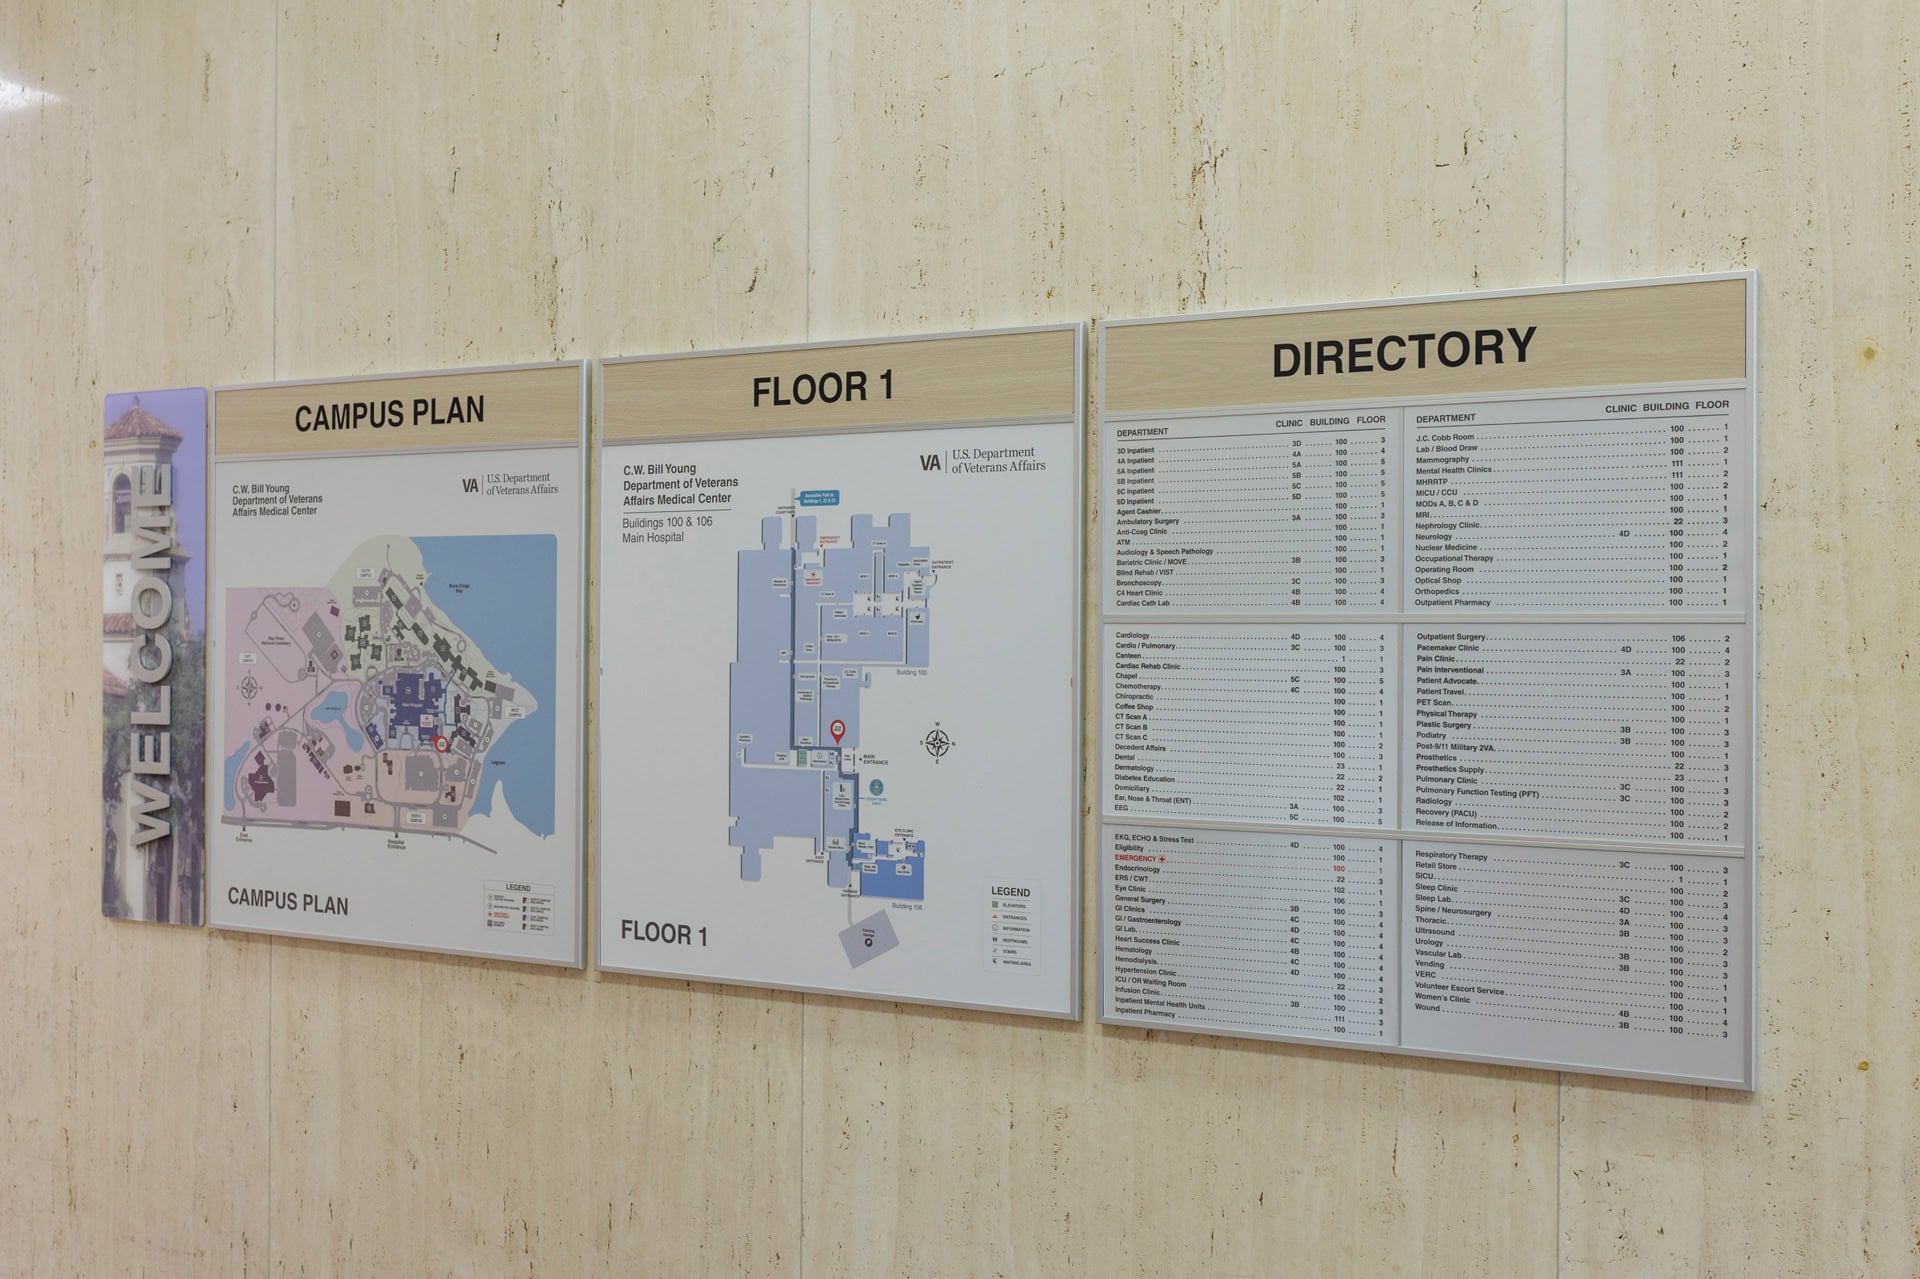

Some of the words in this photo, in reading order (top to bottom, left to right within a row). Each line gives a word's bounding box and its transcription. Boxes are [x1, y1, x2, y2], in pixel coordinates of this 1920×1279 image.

[1274, 326, 1537, 377] DIRECTORY
[754, 371, 866, 407] FLOOR
[880, 369, 891, 399] 1
[296, 400, 403, 432] CAMPUS
[414, 395, 484, 425] PLAN
[1417, 414, 1476, 423] DEPARTMENT
[1606, 404, 1636, 413] CLINIC
[1643, 402, 1689, 411] BUILDING
[1696, 400, 1729, 409] FLOOR
[1117, 428, 1168, 437] DEPARTMENT
[1310, 417, 1349, 426] BUILDING
[952, 449, 970, 460] U.S.
[974, 448, 1034, 461] Department
[1416, 456, 1469, 464] Mammography
[920, 455, 941, 470] VA
[952, 462, 963, 473] of
[964, 463, 1007, 473] Veterans
[1010, 460, 1046, 471] Affairs
[624, 465, 645, 476] C.W.
[648, 464, 663, 474] Bill
[665, 464, 696, 475] Young
[462, 478, 478, 492] VA
[488, 474, 501, 483] U.S.
[503, 473, 550, 485] Department
[624, 480, 680, 492] Department
[683, 478, 693, 488] of
[695, 478, 738, 488] Veterans
[233, 485, 249, 494] C.W.
[252, 484, 264, 493] Bill
[266, 484, 289, 496] Young
[487, 486, 496, 495] of
[494, 486, 529, 495] Veterans
[530, 484, 558, 494] Affairs
[233, 496, 277, 507] Department
[279, 494, 288, 504] of
[289, 495, 322, 504] Veterans
[624, 496, 654, 506] Affairs
[658, 494, 695, 504] Medical
[698, 493, 732, 503] Center
[232, 508, 257, 516] Affairs
[260, 506, 289, 516] Medical
[291, 506, 317, 515] Center
[623, 518, 663, 530] Buildings
[667, 517, 683, 527] 100
[686, 516, 692, 526] &
[697, 516, 712, 526] 106
[623, 533, 644, 543] Main
[647, 532, 684, 544] Hospital
[1417, 633, 1454, 641] Outpatient
[1457, 633, 1485, 642] Surgery
[130, 462, 172, 848] WELCOME
[1115, 764, 1154, 772] Dermatology
[1416, 797, 1452, 806] Radiology
[1416, 850, 1457, 860] Respiratory
[1458, 853, 1488, 862] Therapy
[1115, 864, 1160, 874] Endocrinology
[992, 886, 1030, 897] LEGEND
[228, 887, 297, 910] CAMPUS
[304, 894, 348, 915] PLAN
[892, 902, 912, 911] Building
[622, 920, 690, 945] FLOOR
[699, 927, 706, 946] 1
[1416, 927, 1455, 936] Ultrasound
[1415, 1003, 1440, 1011] Wound
